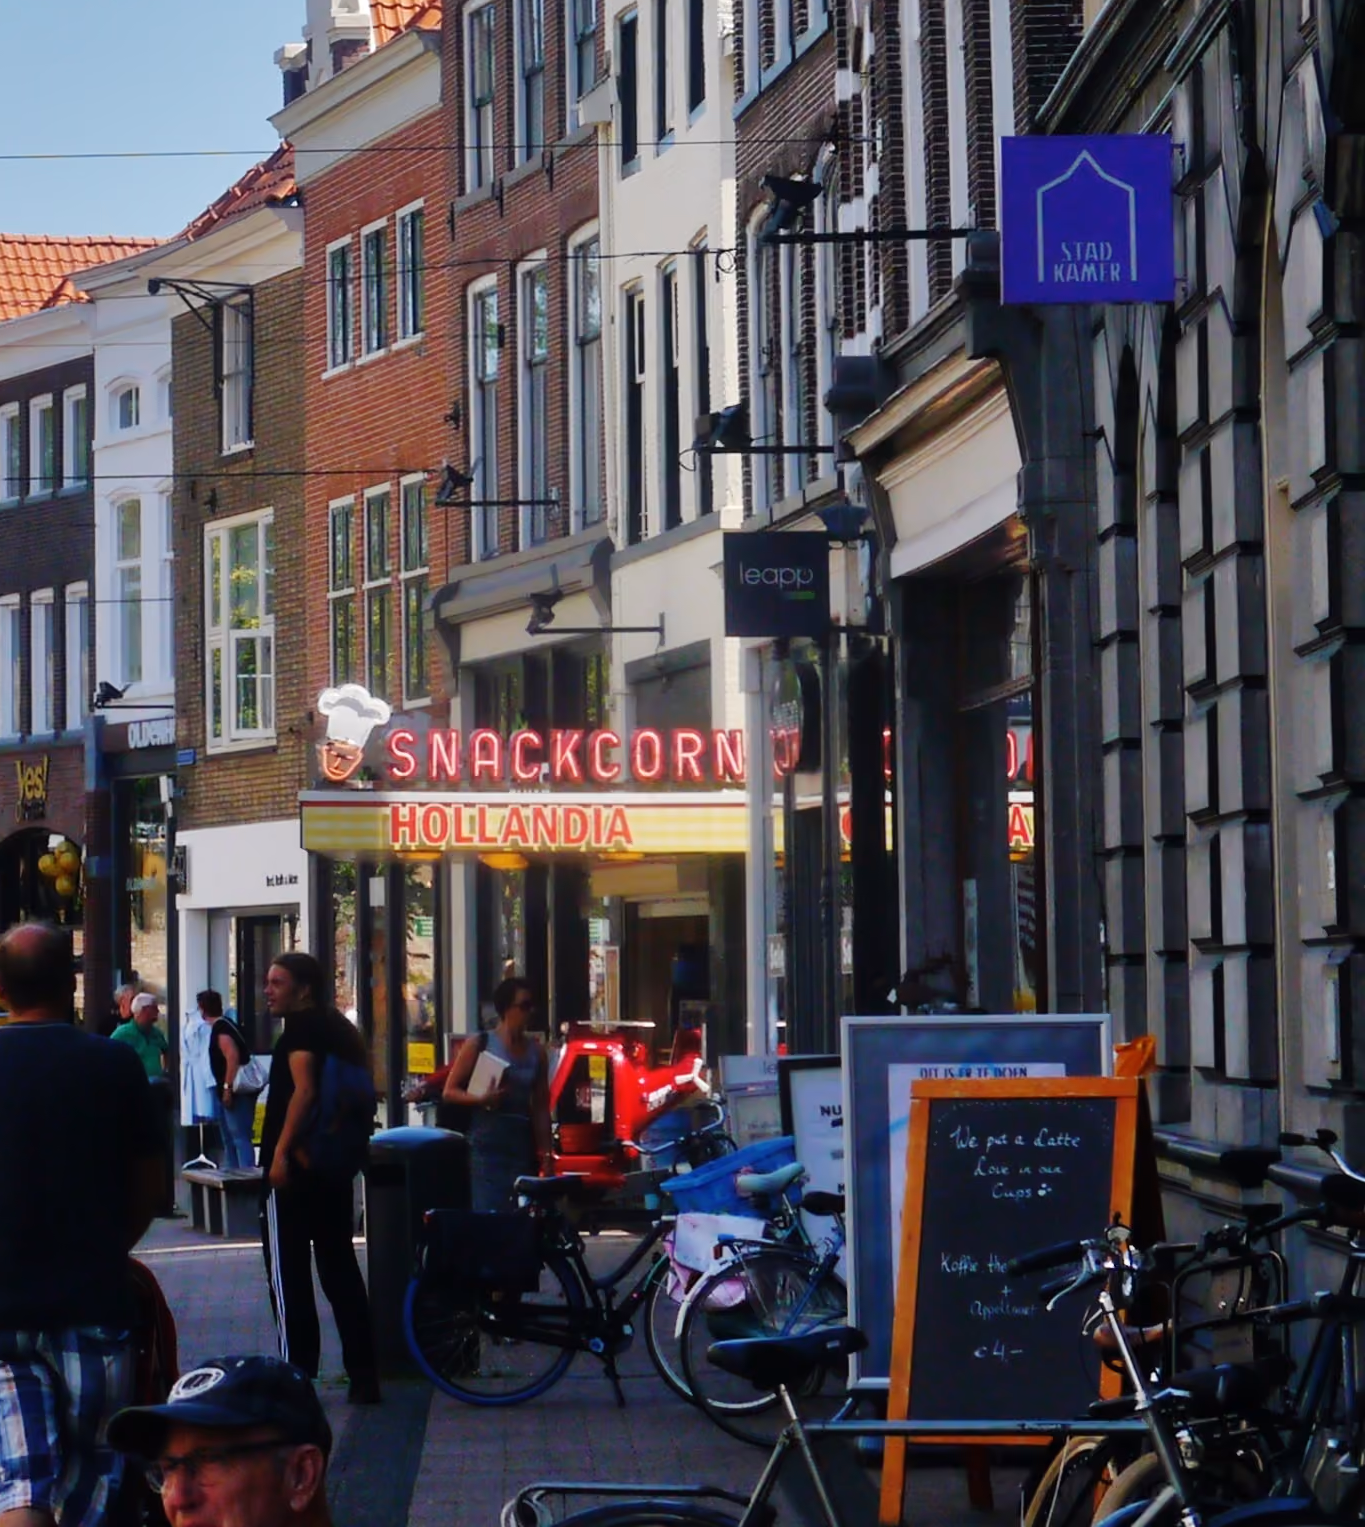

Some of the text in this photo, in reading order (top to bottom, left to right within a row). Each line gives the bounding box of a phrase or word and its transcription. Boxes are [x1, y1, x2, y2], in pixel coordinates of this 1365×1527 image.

[1062, 241, 1112, 261] STAD
[1054, 263, 1120, 283] KAMER
[740, 561, 814, 590] leapp
[387, 728, 746, 783] SNACKCORN
[389, 804, 634, 847] HOLLANDIA
[950, 1125, 978, 1149] We
[986, 1132, 1009, 1153] put
[1014, 1135, 1026, 1146] a
[973, 1155, 1010, 1177] Love
[992, 1182, 1033, 1202] Cups
[986, 1252, 1009, 1274] the
